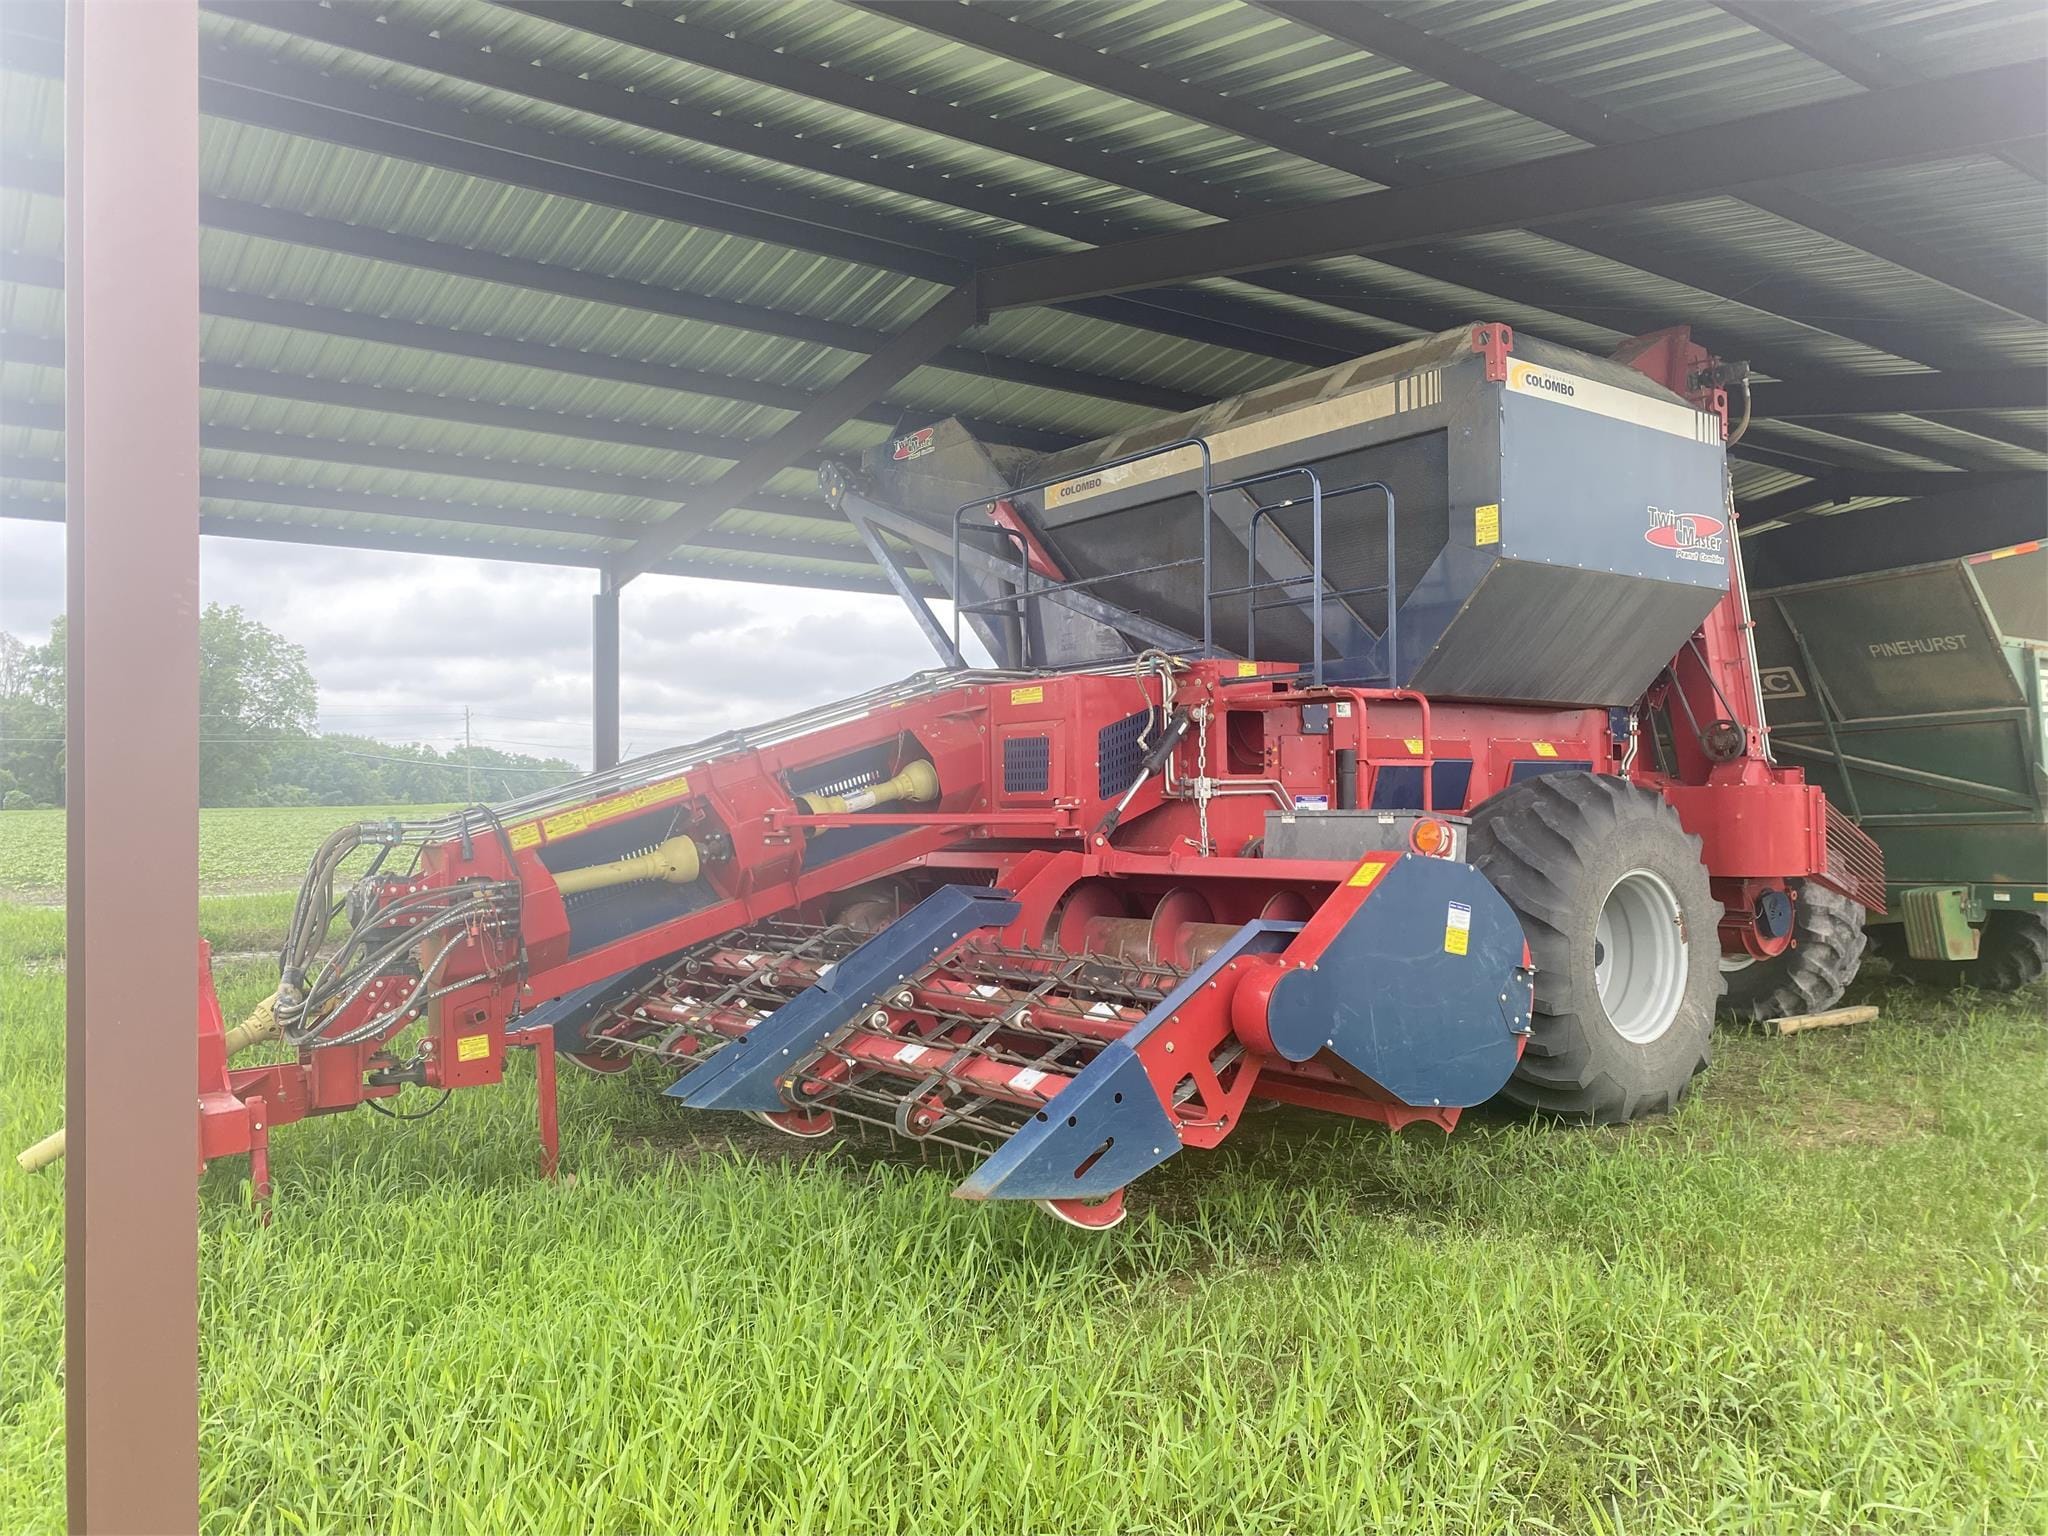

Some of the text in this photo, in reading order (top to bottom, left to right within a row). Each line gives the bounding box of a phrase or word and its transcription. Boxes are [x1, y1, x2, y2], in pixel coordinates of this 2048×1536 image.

[1526, 374, 1575, 397] COLOMBO
[1060, 478, 1102, 497] COLOMBO
[1648, 506, 1684, 533] Twin
[1682, 525, 1722, 551] Master
[1869, 634, 1967, 658] PINEHURST
